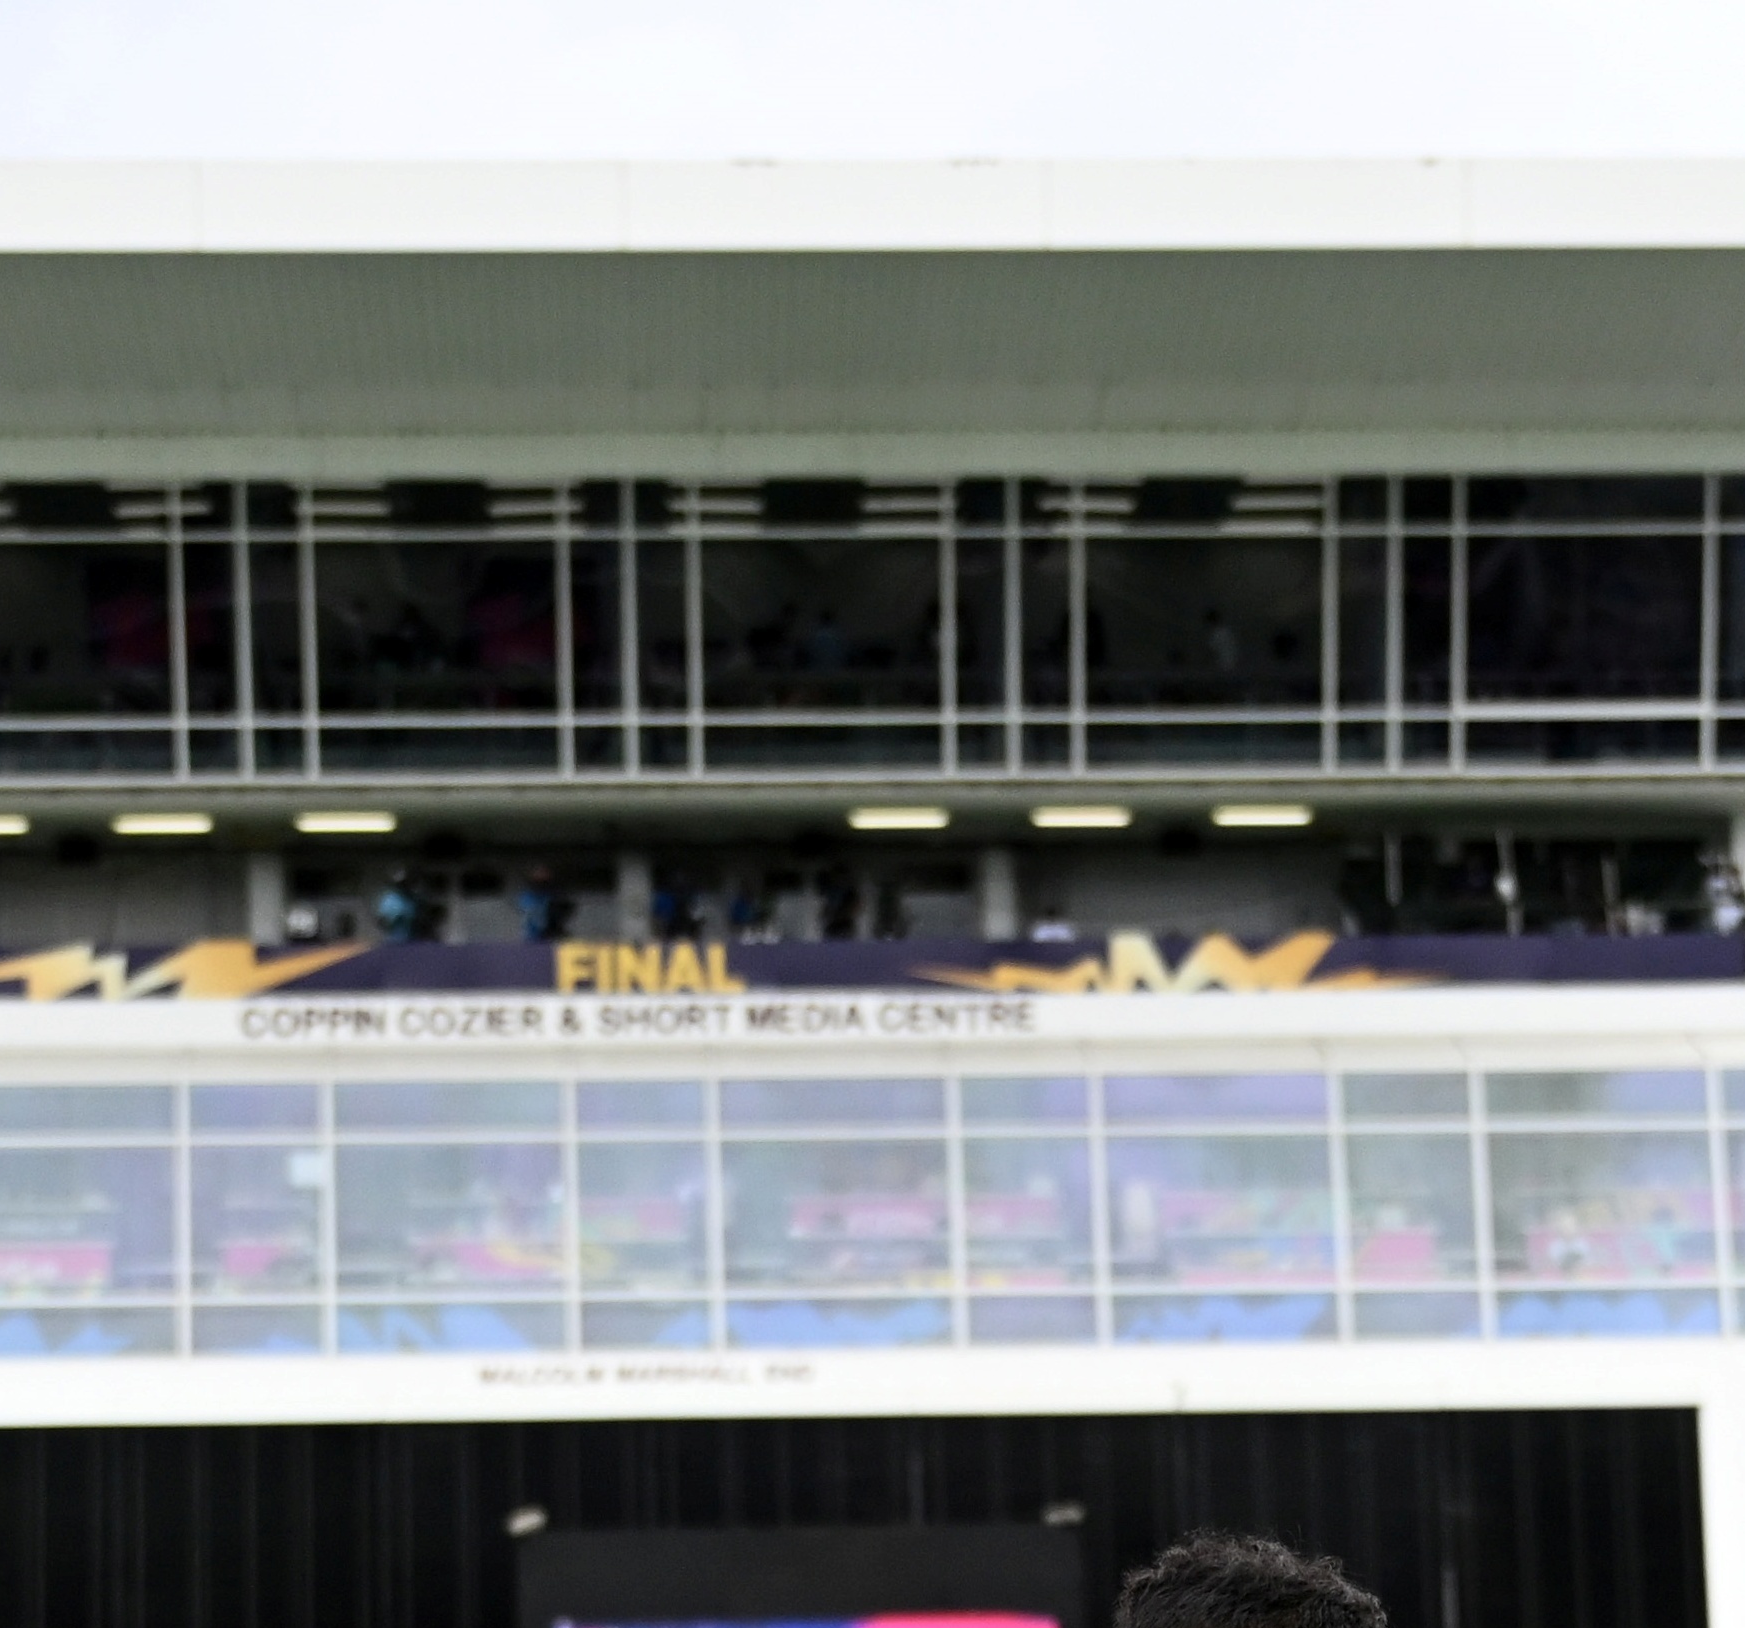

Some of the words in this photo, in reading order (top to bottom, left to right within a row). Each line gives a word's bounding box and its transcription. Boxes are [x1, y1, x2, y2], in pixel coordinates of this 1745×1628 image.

[556, 941, 747, 995] FINAL
[240, 1006, 387, 1039] COPPIN
[397, 1006, 545, 1037] COZIER
[559, 1007, 585, 1035] &
[597, 1004, 731, 1036] SHORT
[745, 1003, 865, 1034] MEDIA
[876, 1002, 1036, 1033] CENTRE
